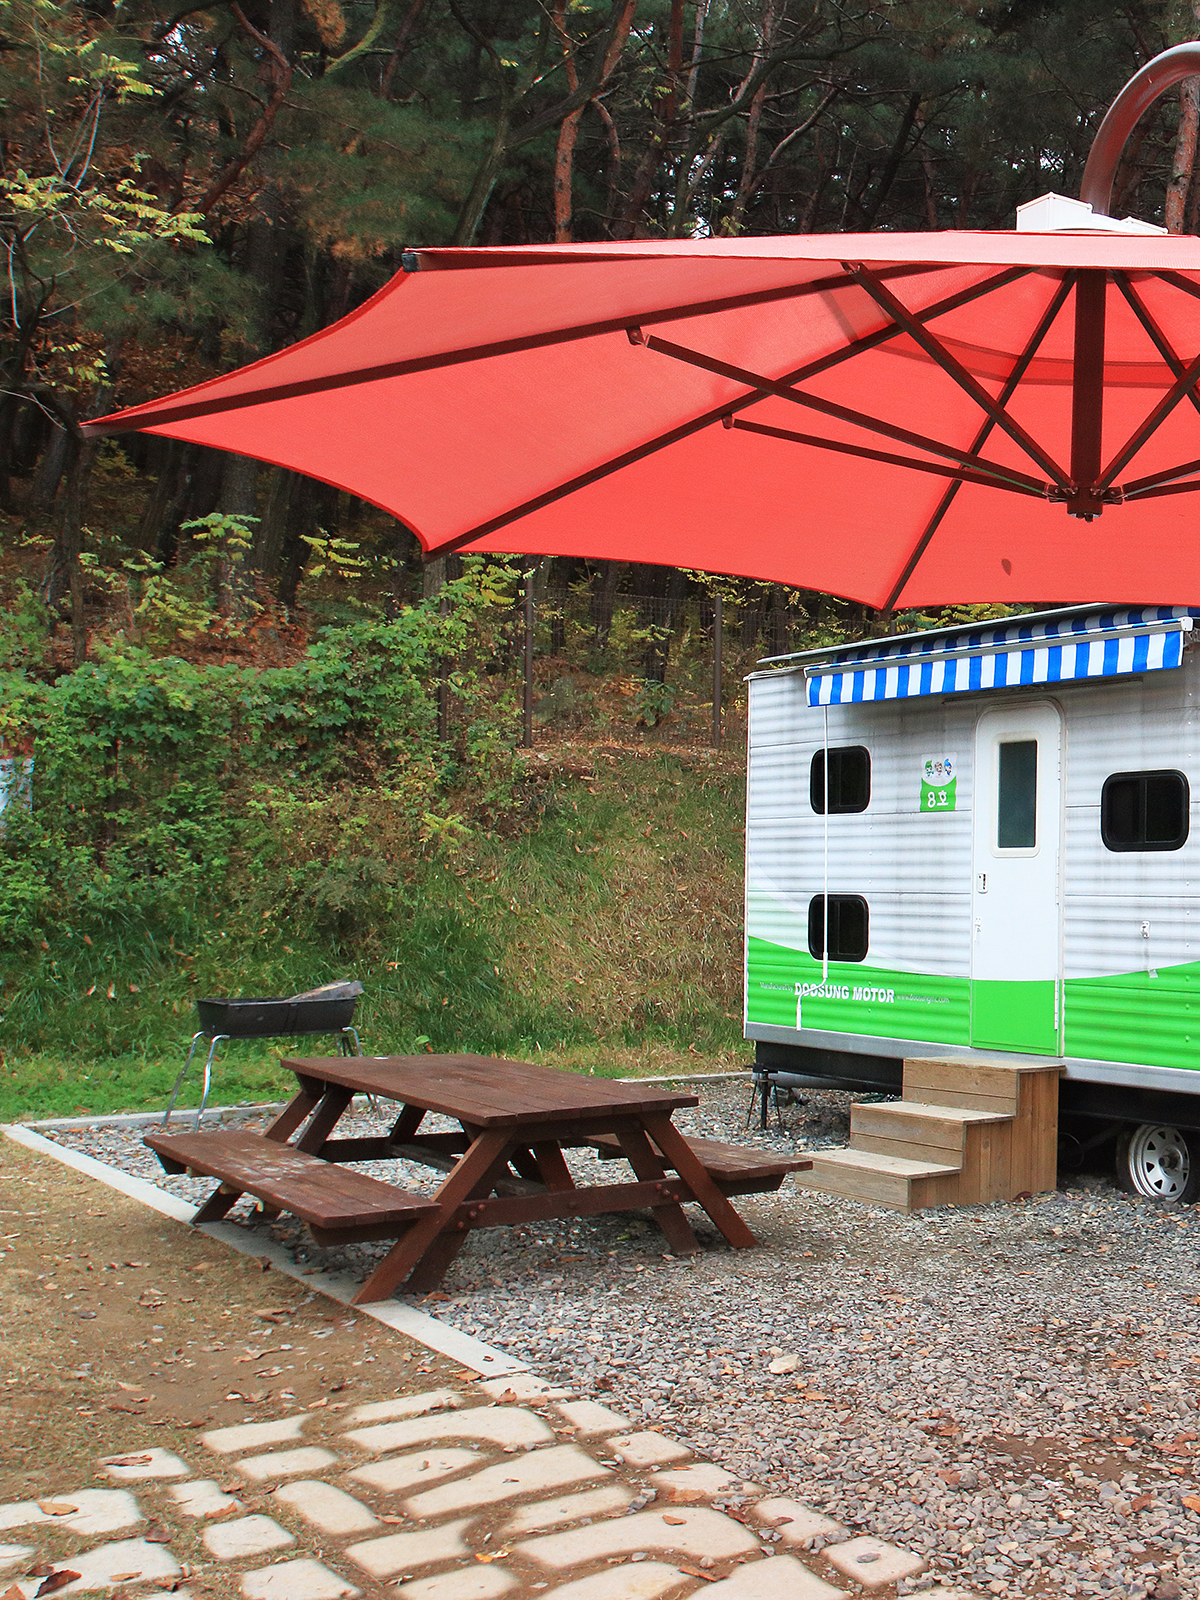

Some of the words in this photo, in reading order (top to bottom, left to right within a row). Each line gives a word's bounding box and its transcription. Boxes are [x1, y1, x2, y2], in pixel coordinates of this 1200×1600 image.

[927, 790, 949, 808] 8호
[794, 982, 850, 1000] DOOSUNG
[852, 986, 895, 1004] MOTOR
